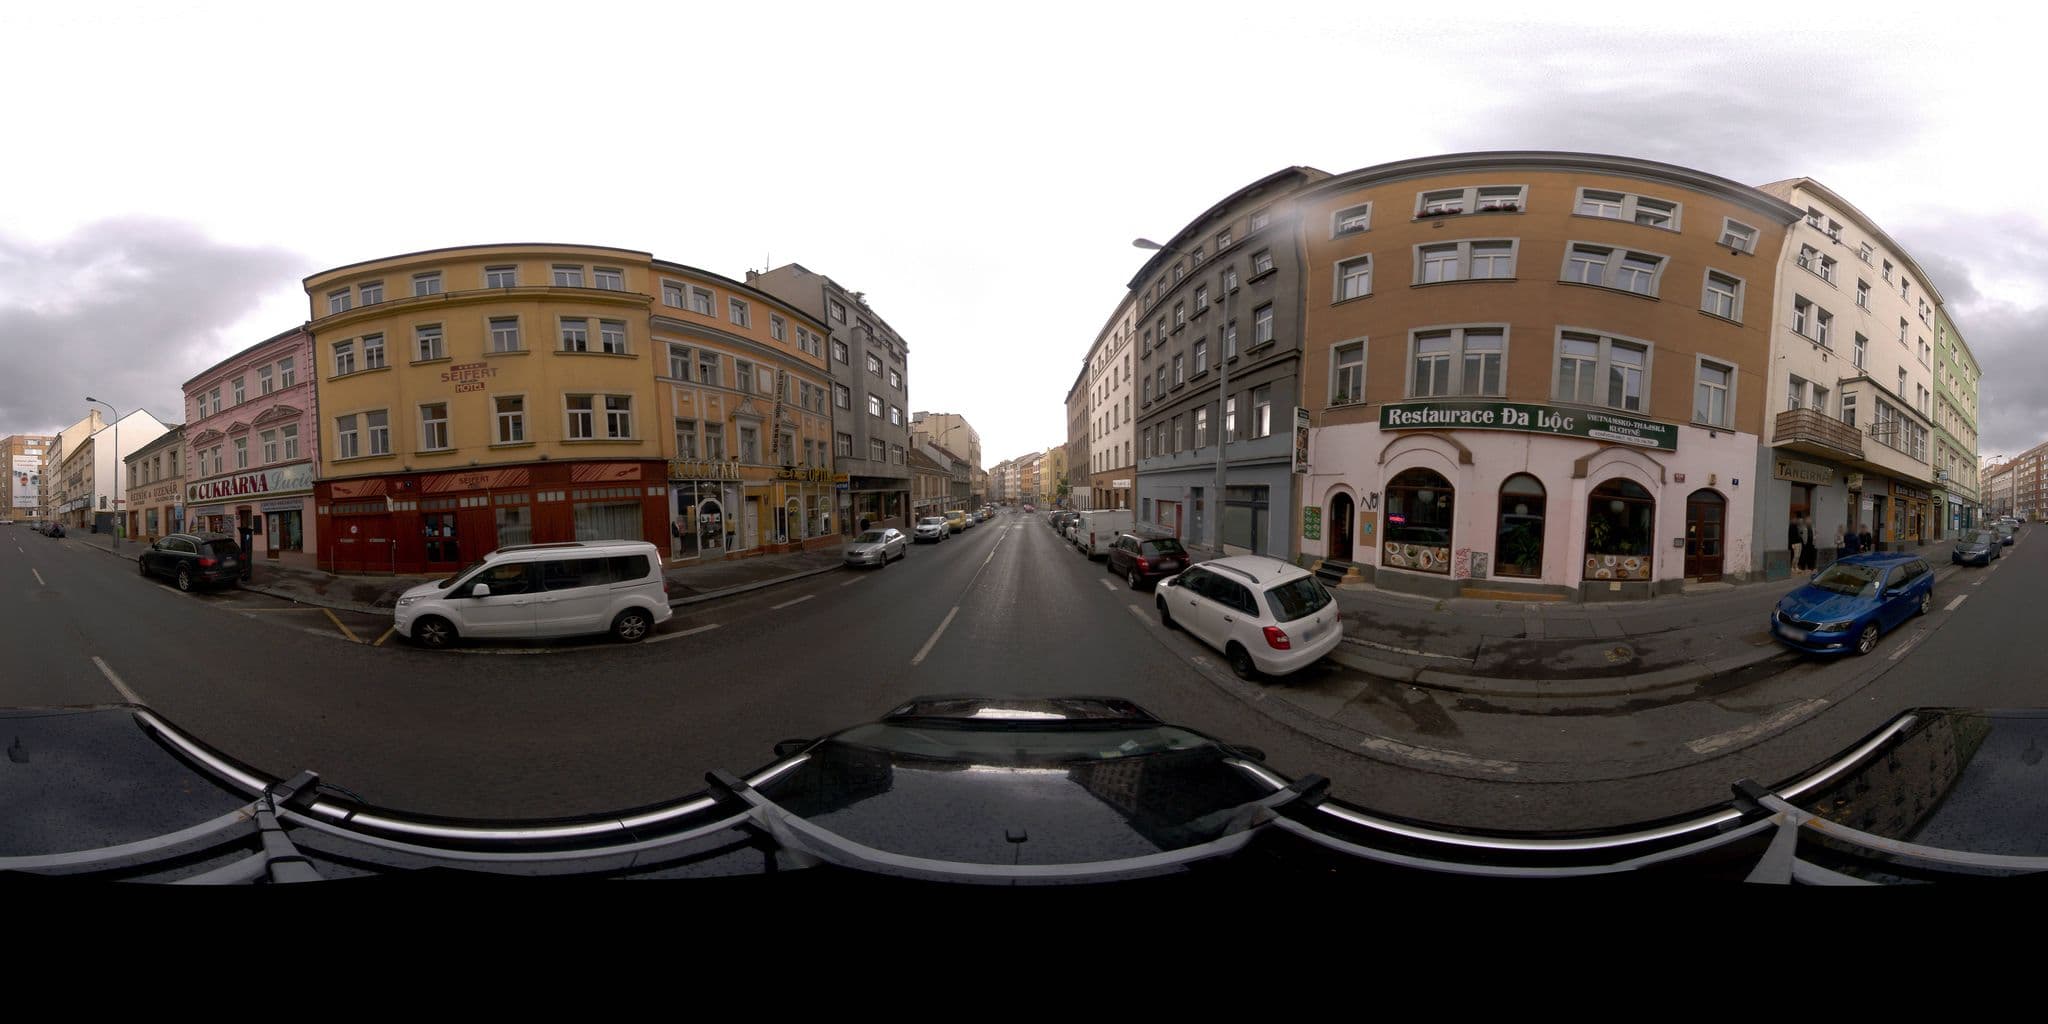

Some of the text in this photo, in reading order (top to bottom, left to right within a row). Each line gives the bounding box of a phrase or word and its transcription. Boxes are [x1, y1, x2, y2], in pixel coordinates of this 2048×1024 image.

[441, 368, 498, 383] SEIFERT
[456, 382, 486, 393] HOTEL
[1388, 407, 1574, 432] Restaurace Đa Lộc
[199, 473, 269, 499] CUKRÁRNA
